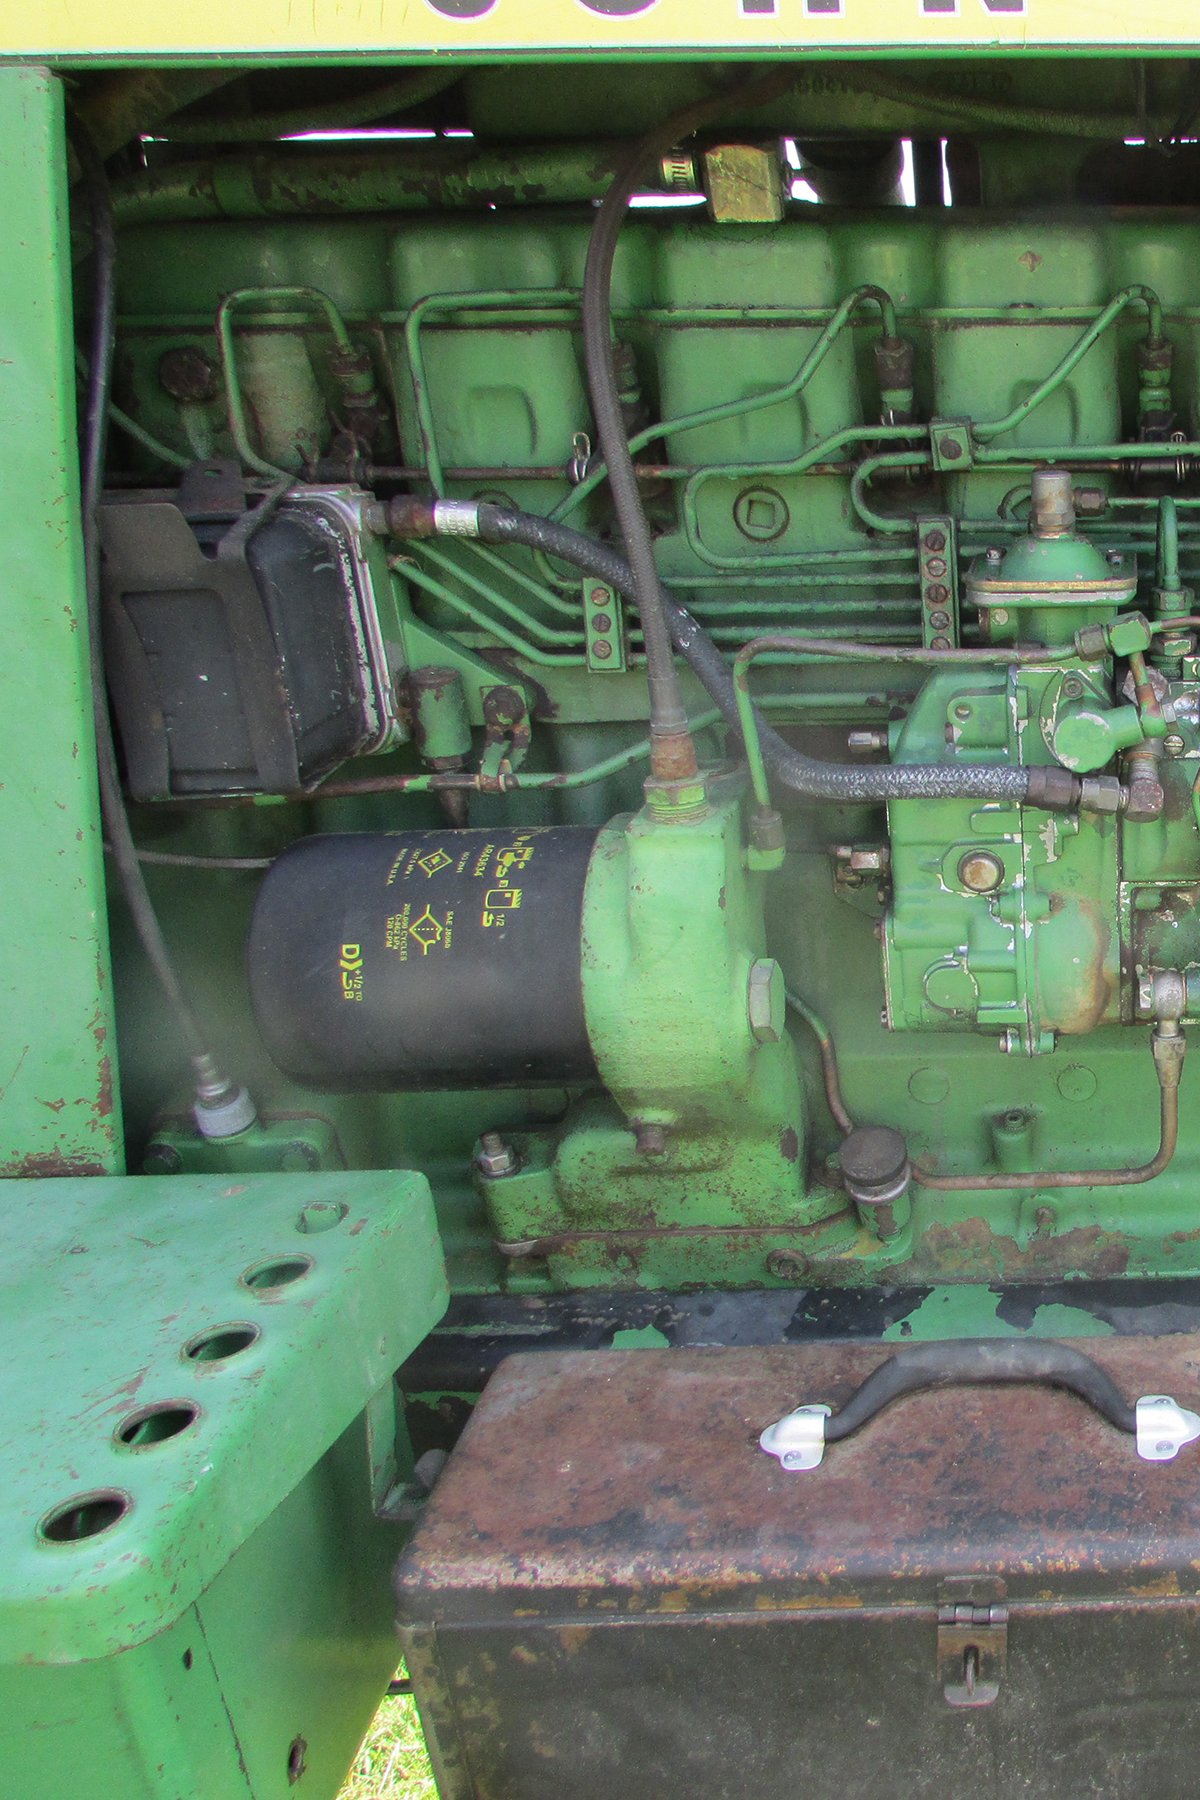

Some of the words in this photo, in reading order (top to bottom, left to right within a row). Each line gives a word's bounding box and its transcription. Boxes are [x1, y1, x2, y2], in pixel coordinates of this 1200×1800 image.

[445, 910, 454, 925] SAE
[496, 913, 505, 927] 1/2
[386, 930, 394, 948] CPM
[400, 930, 409, 961] CYCLES
[355, 991, 363, 1001] TO
